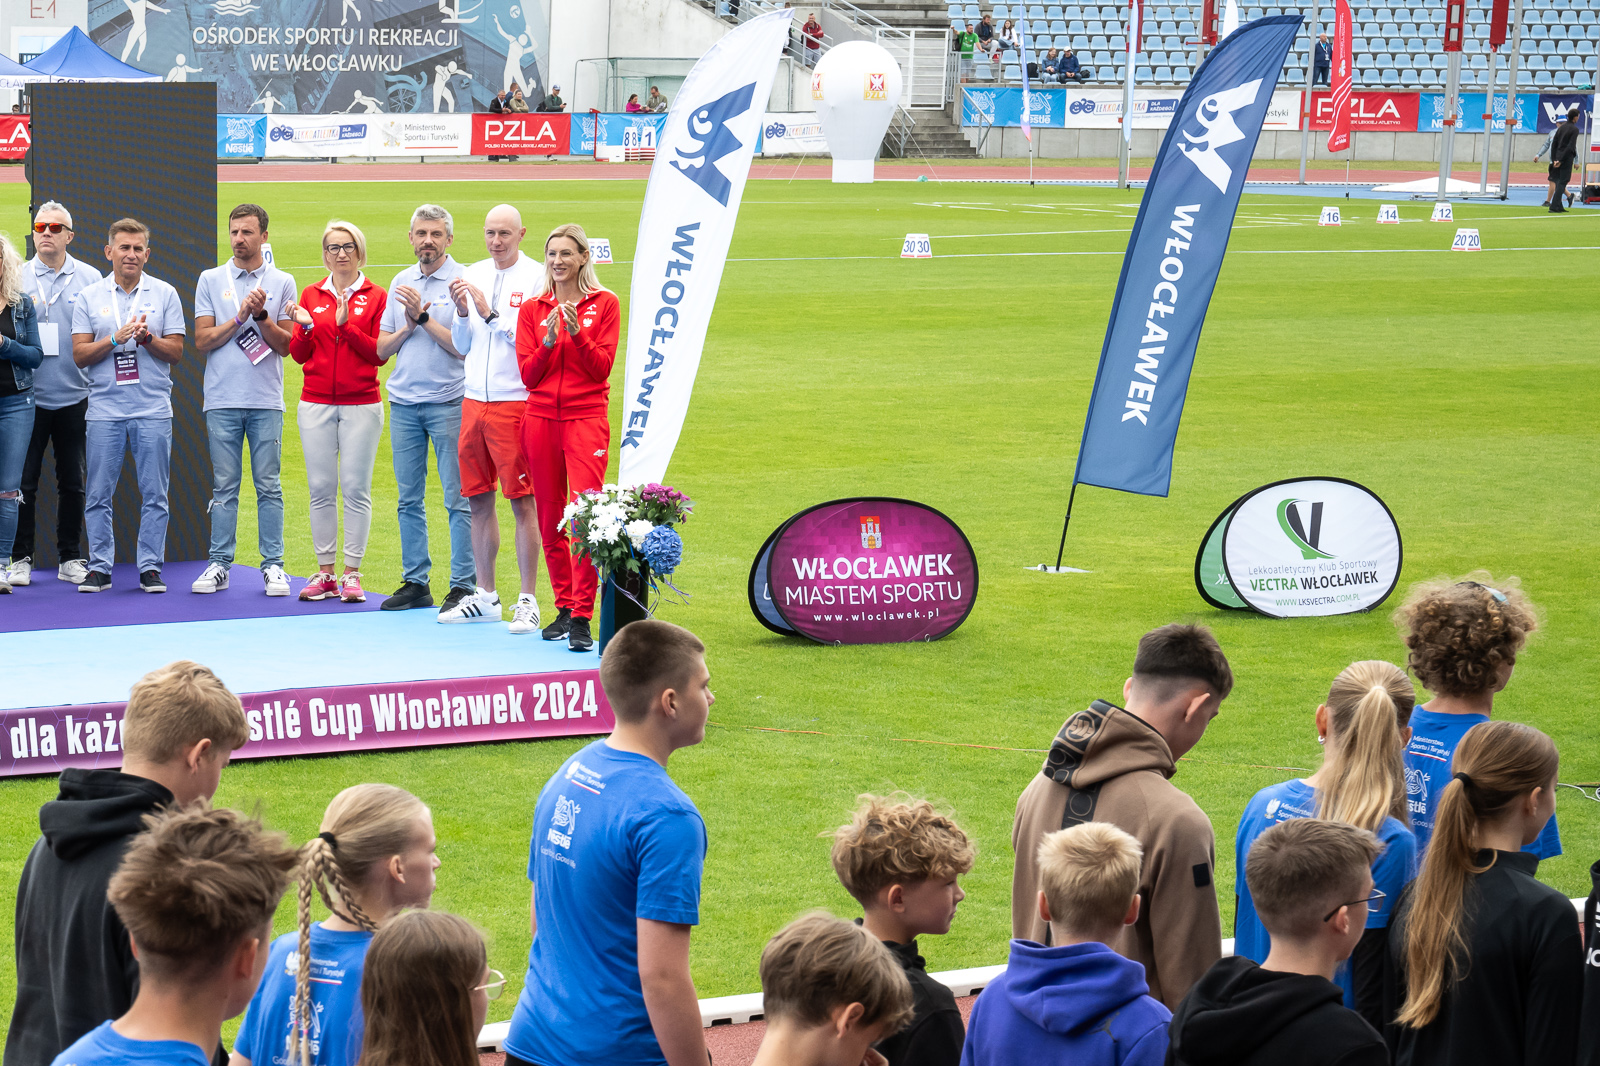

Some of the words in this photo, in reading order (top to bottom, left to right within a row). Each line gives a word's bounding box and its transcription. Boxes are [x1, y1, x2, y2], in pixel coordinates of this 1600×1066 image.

[193, 22, 280, 45] OŚRODEK
[284, 27, 354, 46] SPORTU
[359, 28, 364, 46] I
[368, 28, 459, 47] REKREACJI
[250, 54, 280, 71] WE
[284, 54, 403, 72] WŁOCŁAWKU
[865, 91, 886, 99] PZLA
[1021, 114, 1051, 124] estlé
[404, 123, 446, 131] Ministerstwo
[485, 120, 556, 141] PZLA
[404, 133, 426, 142] Sportu
[431, 133, 459, 142] Turystyki
[624, 132, 630, 146] 8
[645, 132, 652, 146] 1
[226, 143, 254, 154] Nestlé
[1326, 212, 1339, 222] 16
[1384, 209, 1397, 220] 14
[1439, 208, 1451, 219] 12
[903, 240, 916, 253] 30
[917, 240, 930, 253] 30
[1454, 234, 1467, 246] 20
[1467, 235, 1480, 247] 20
[596, 245, 610, 259] 35
[1121, 203, 1201, 427] WŁOCŁAWEK
[620, 221, 701, 449] WŁOCŁAWEK
[791, 553, 955, 580] WŁOCŁAWEK
[1248, 563, 1316, 576] Lekkoatletyczny
[1318, 561, 1337, 572] Klub
[1340, 559, 1378, 571] Sportowy
[1250, 577, 1299, 592] VECTRA
[1300, 570, 1379, 590] WŁOCŁAWEK
[785, 585, 877, 606] MIASTEM
[882, 580, 962, 604] SPORTU
[1275, 593, 1361, 607] WWW.LKSVECTRA.COM.PL
[813, 607, 940, 622] www.wloclawek.pl
[10, 717, 58, 759] dla
[249, 697, 302, 741] stlé
[309, 698, 363, 741] Cup
[369, 685, 526, 733] Włocławek
[533, 679, 598, 722] 2024
[1410, 742, 1427, 753] Sportu
[1413, 735, 1444, 747] Ministerstwo
